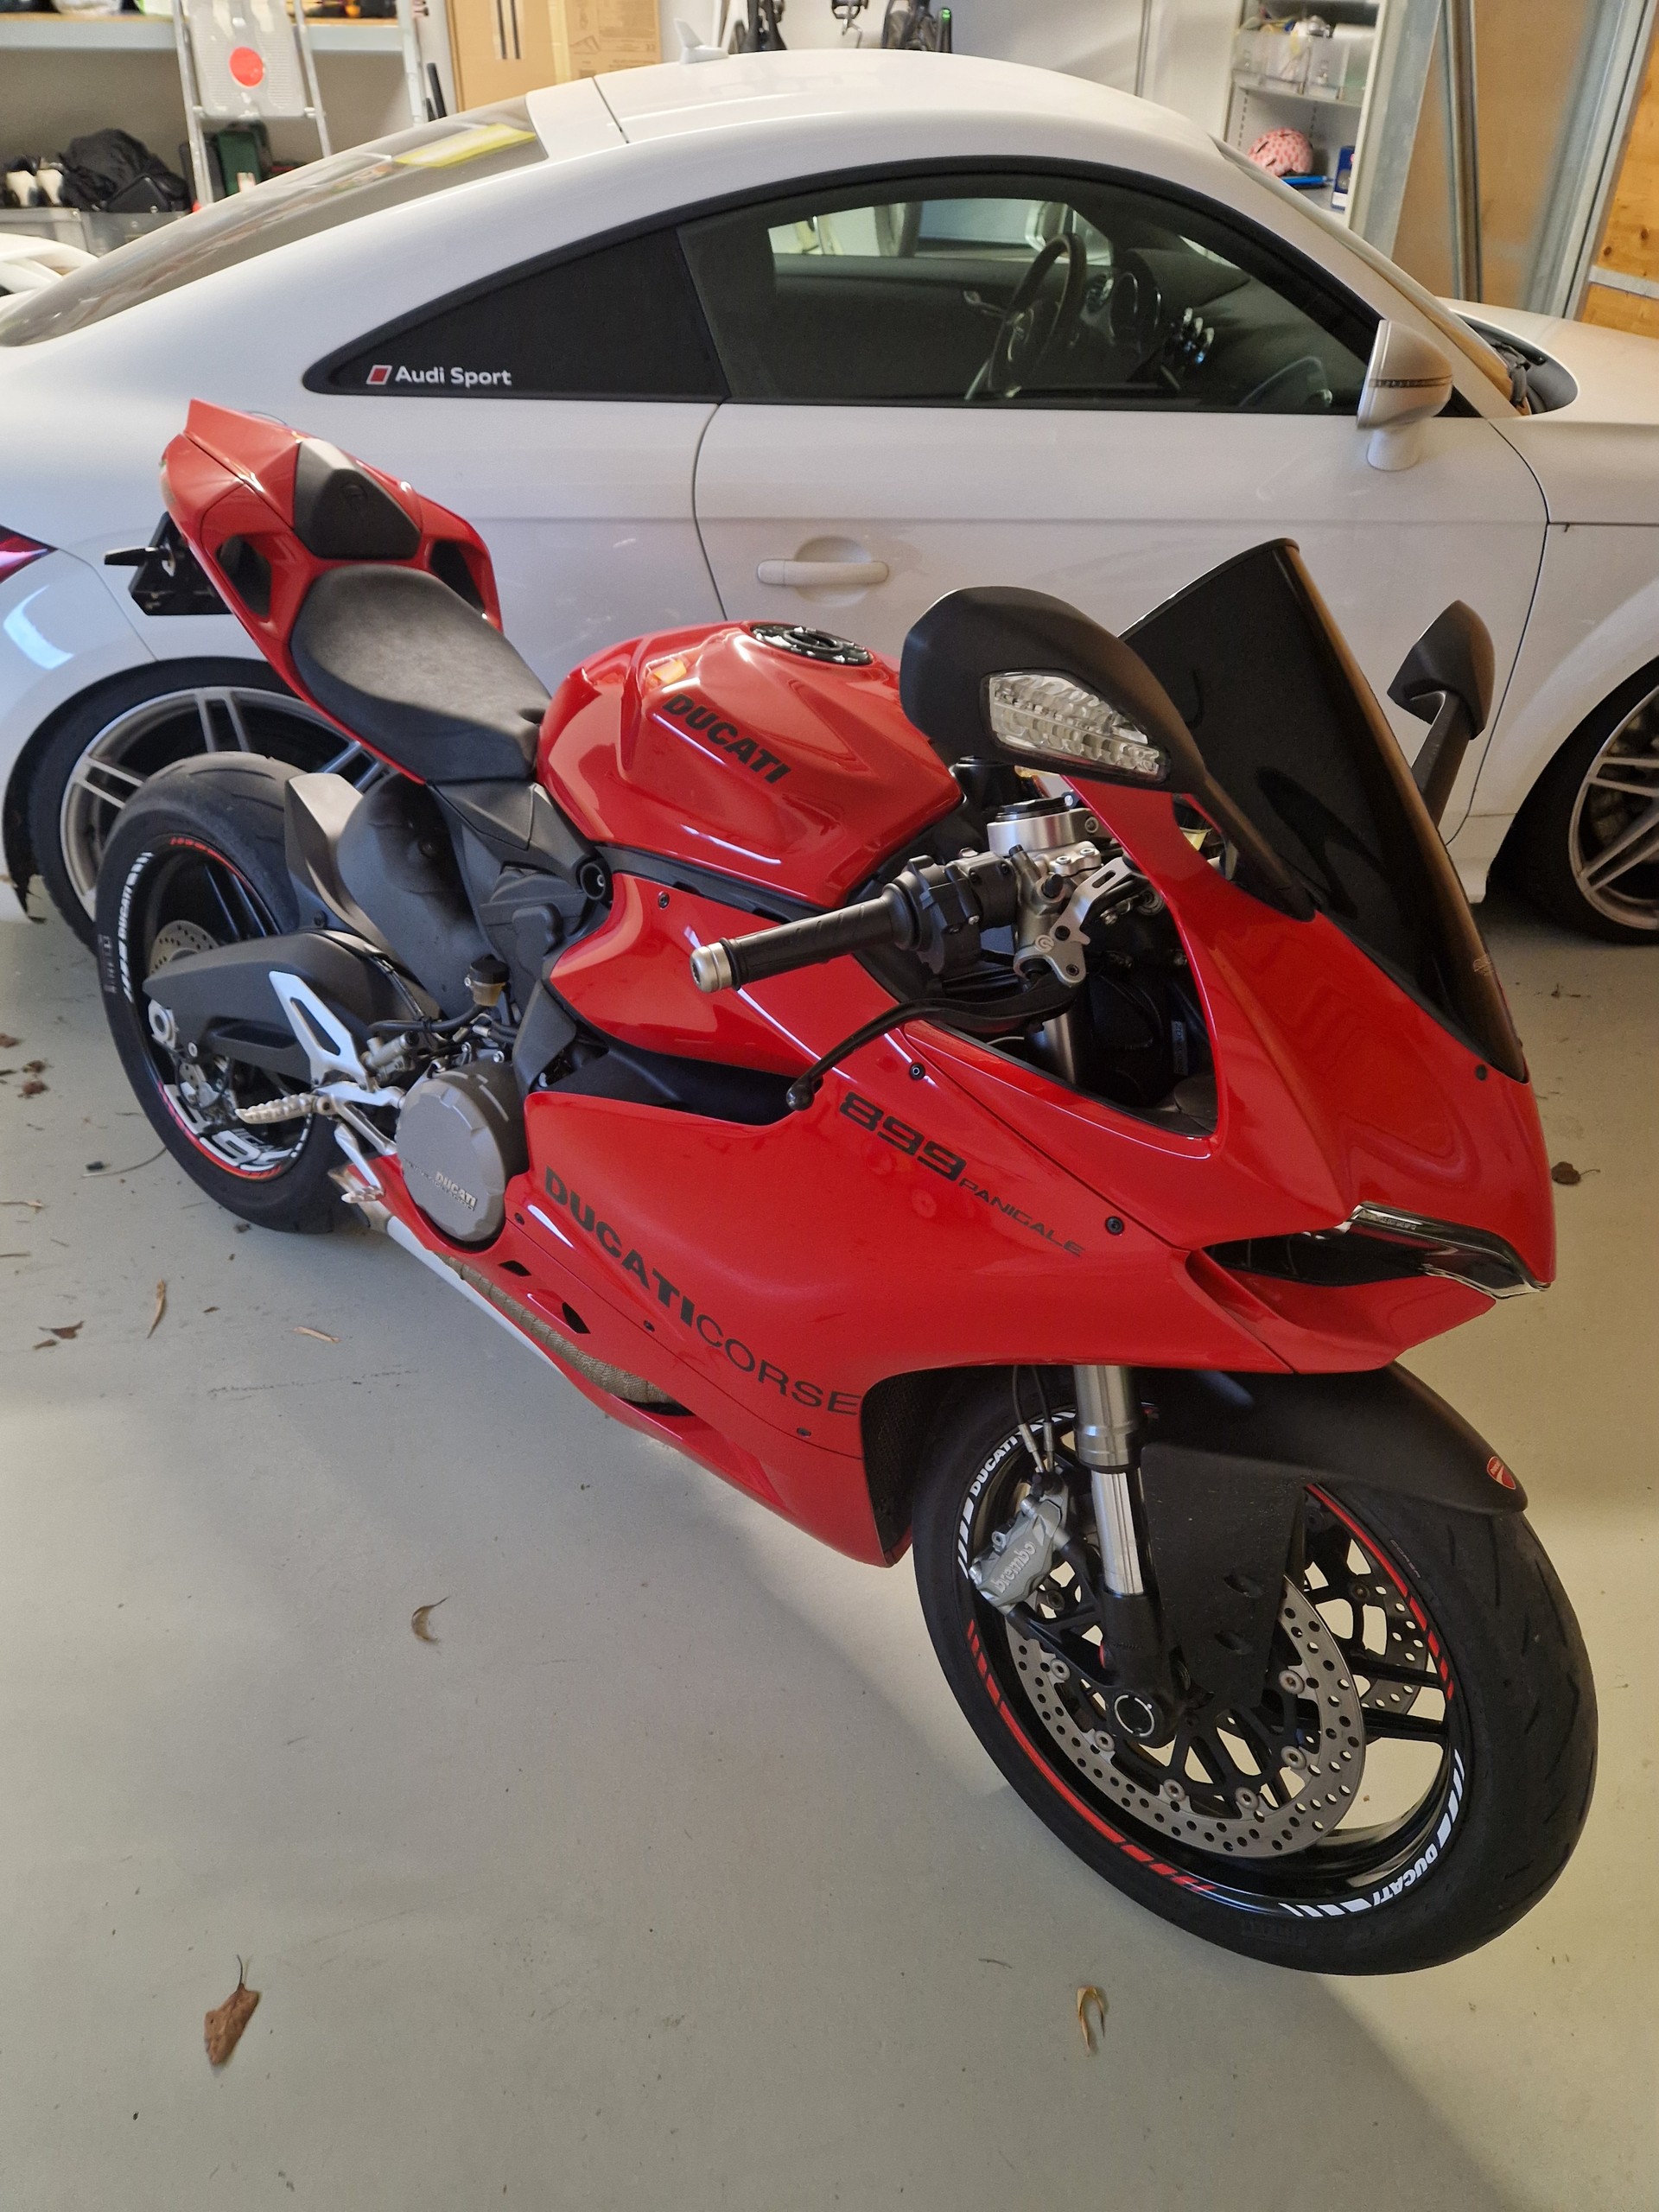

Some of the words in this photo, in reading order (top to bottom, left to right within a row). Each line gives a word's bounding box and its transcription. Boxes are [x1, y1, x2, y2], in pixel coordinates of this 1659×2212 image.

[395, 365, 445, 384] Audi
[450, 366, 512, 388] Sport
[662, 693, 791, 784] DUCATI
[435, 1171, 477, 1208] DUCATI
[840, 1091, 967, 1182] 899
[958, 1177, 1085, 1257] PANIGALE
[545, 1166, 696, 1328] DUCATI
[696, 1313, 863, 1416] CORSE
[969, 1435, 1019, 1497] DUCATI
[991, 1541, 1036, 1593] brembo
[1372, 1843, 1439, 1906] DUCATI
